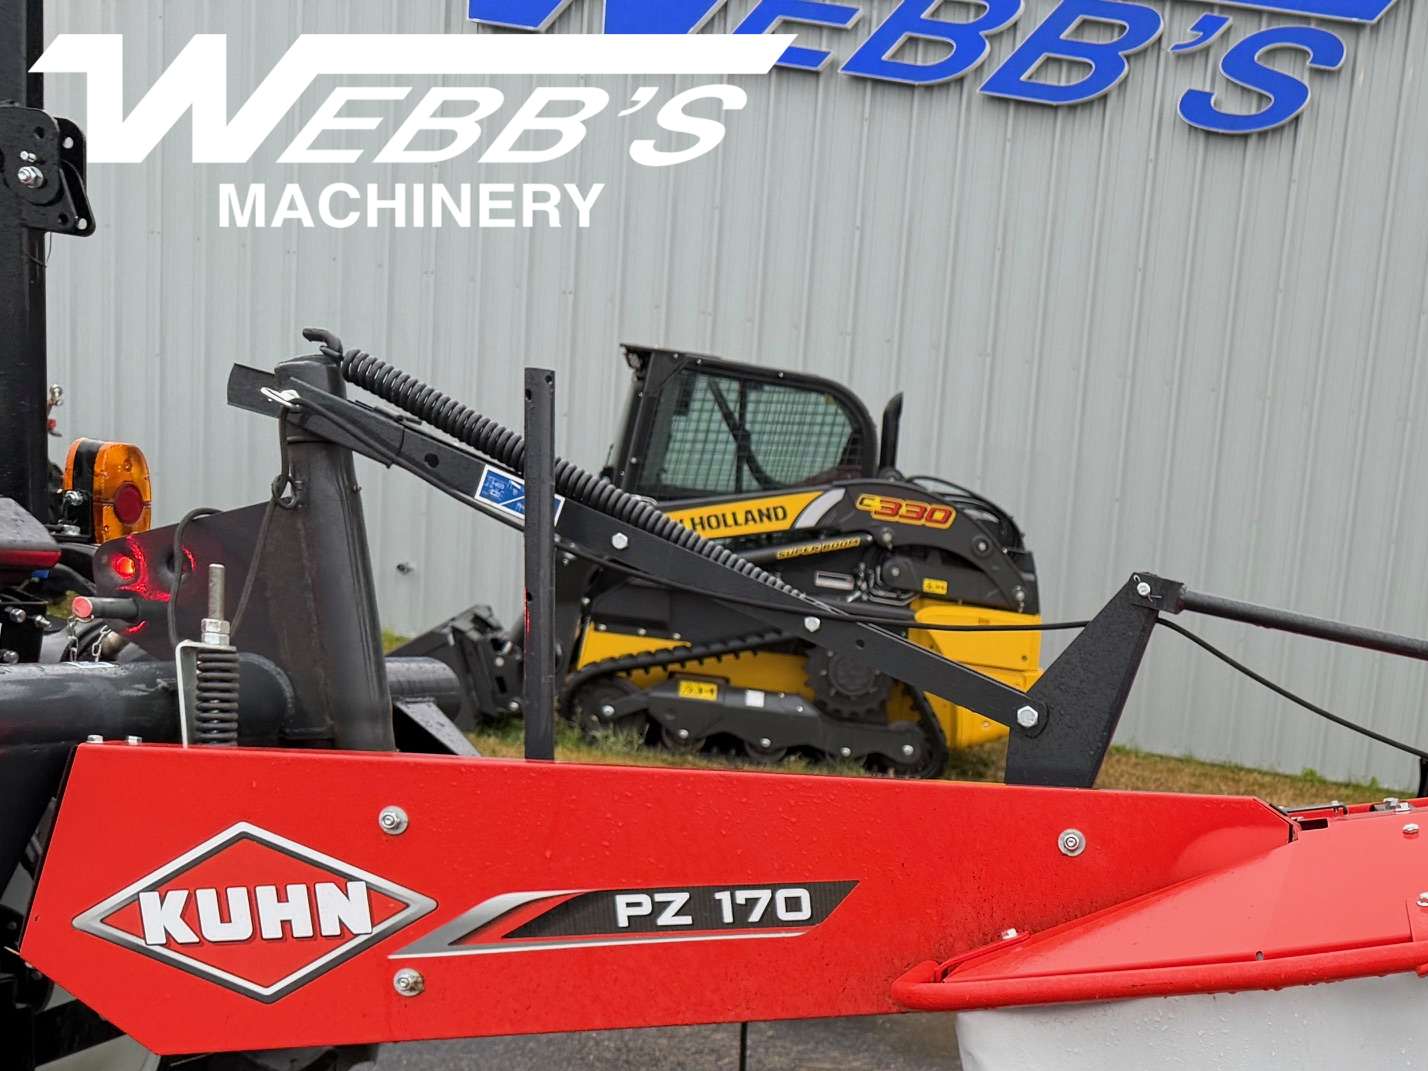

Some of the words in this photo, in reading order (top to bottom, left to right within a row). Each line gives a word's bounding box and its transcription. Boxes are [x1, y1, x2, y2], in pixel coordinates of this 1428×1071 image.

[690, 505, 788, 531] HOLLAND
[138, 881, 373, 945] KUHN
[615, 892, 693, 928] PZ
[714, 888, 812, 924] 170
